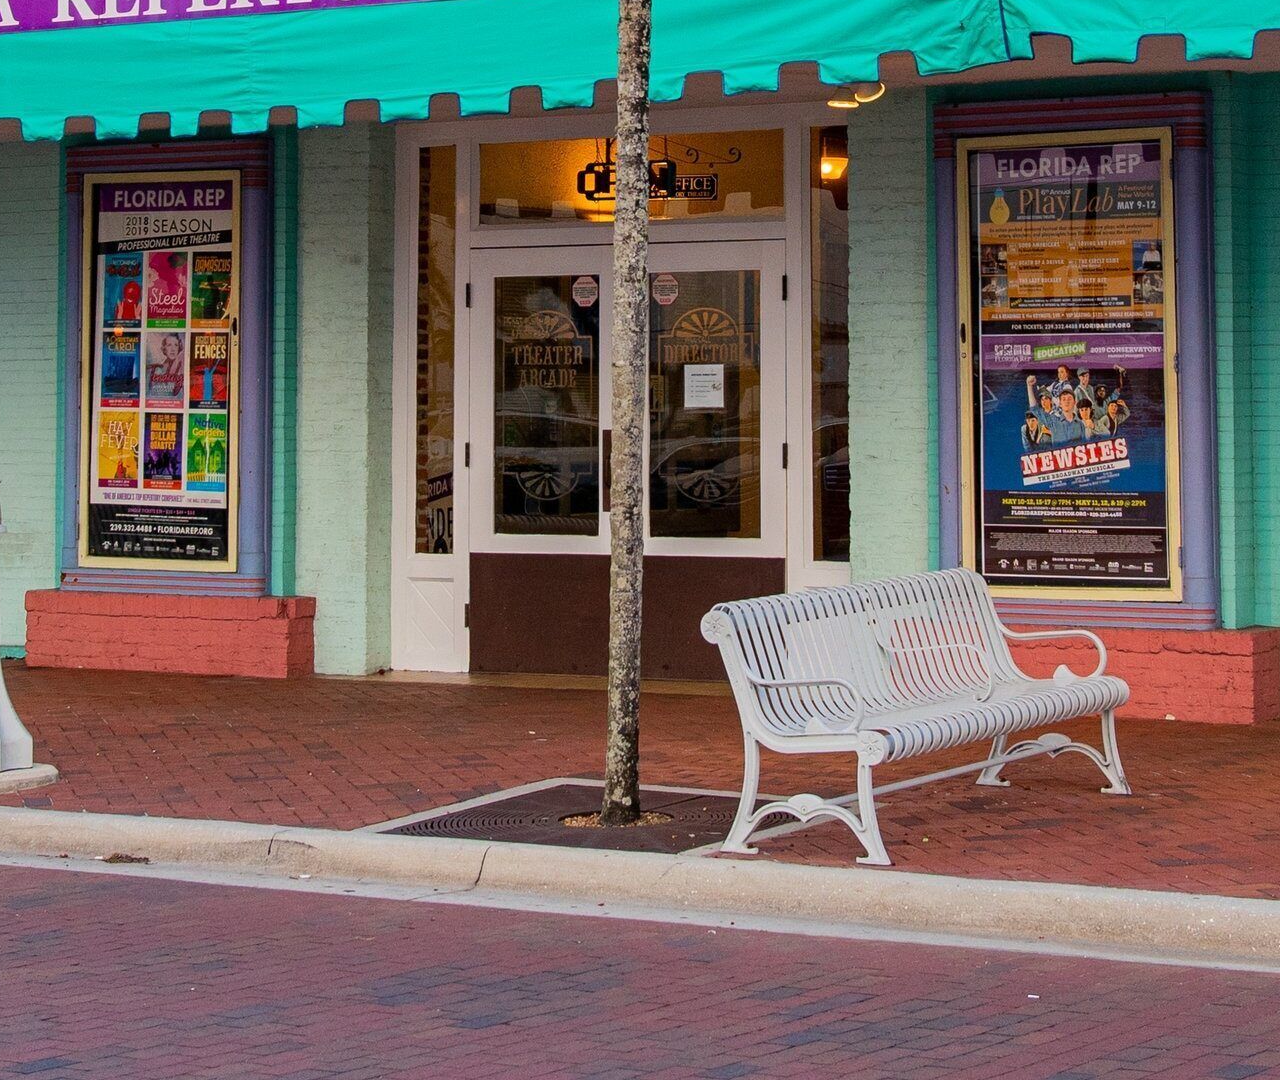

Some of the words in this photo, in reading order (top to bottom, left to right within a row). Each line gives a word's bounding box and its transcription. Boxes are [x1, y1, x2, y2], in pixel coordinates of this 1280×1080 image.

[997, 155, 1092, 178] FLORIDA
[1100, 154, 1141, 175] REP
[675, 177, 711, 191] FFICE
[114, 189, 188, 208] FLORIDA
[194, 188, 225, 206] REP
[1117, 201, 1134, 210] MAY
[1137, 200, 1156, 209] 9-12
[126, 217, 149, 226] 2018
[153, 218, 212, 232] SEASON
[126, 226, 149, 235] 2019
[117, 238, 170, 252] PROFESSIONAL
[172, 236, 187, 246] LIVE
[190, 233, 220, 243] THEATRE
[149, 288, 185, 306] Steel
[149, 305, 183, 316] Magnolias
[108, 342, 137, 351] CAROL
[195, 344, 227, 359] FENCES
[1037, 344, 1086, 359] EDUCATION
[1107, 346, 1162, 354] CONSERVATORY
[512, 345, 583, 366] THEATER
[108, 421, 133, 436] HAY
[193, 417, 224, 429] Native
[192, 427, 225, 438] Gardens
[100, 434, 138, 453] FEVER
[1021, 438, 1129, 475] NEWSIES
[1052, 469, 1084, 479] BROADWAY
[1085, 464, 1115, 474] MUSICAL
[428, 479, 448, 497] RIDA
[110, 524, 152, 532] 239.332.4488
[157, 525, 213, 535] FLORIDAREP.ORG
